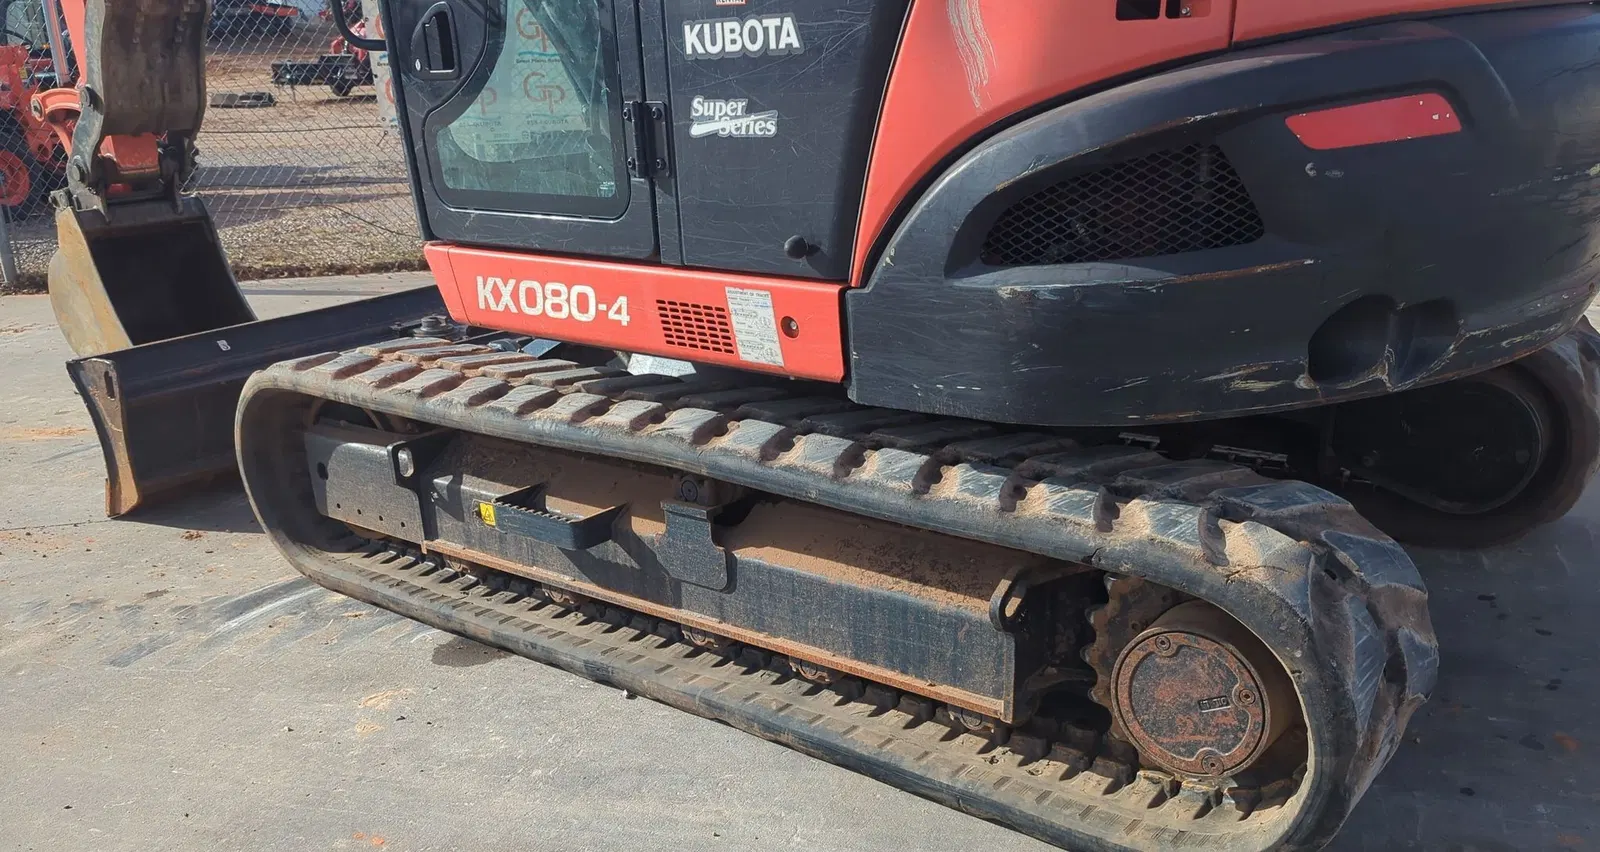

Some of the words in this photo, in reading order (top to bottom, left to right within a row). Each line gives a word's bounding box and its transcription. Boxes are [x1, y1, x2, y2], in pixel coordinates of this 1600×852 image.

[684, 16, 801, 55] KUBOTA
[692, 97, 747, 121] Super
[718, 115, 776, 135] Series
[476, 275, 630, 327] KX080-4
